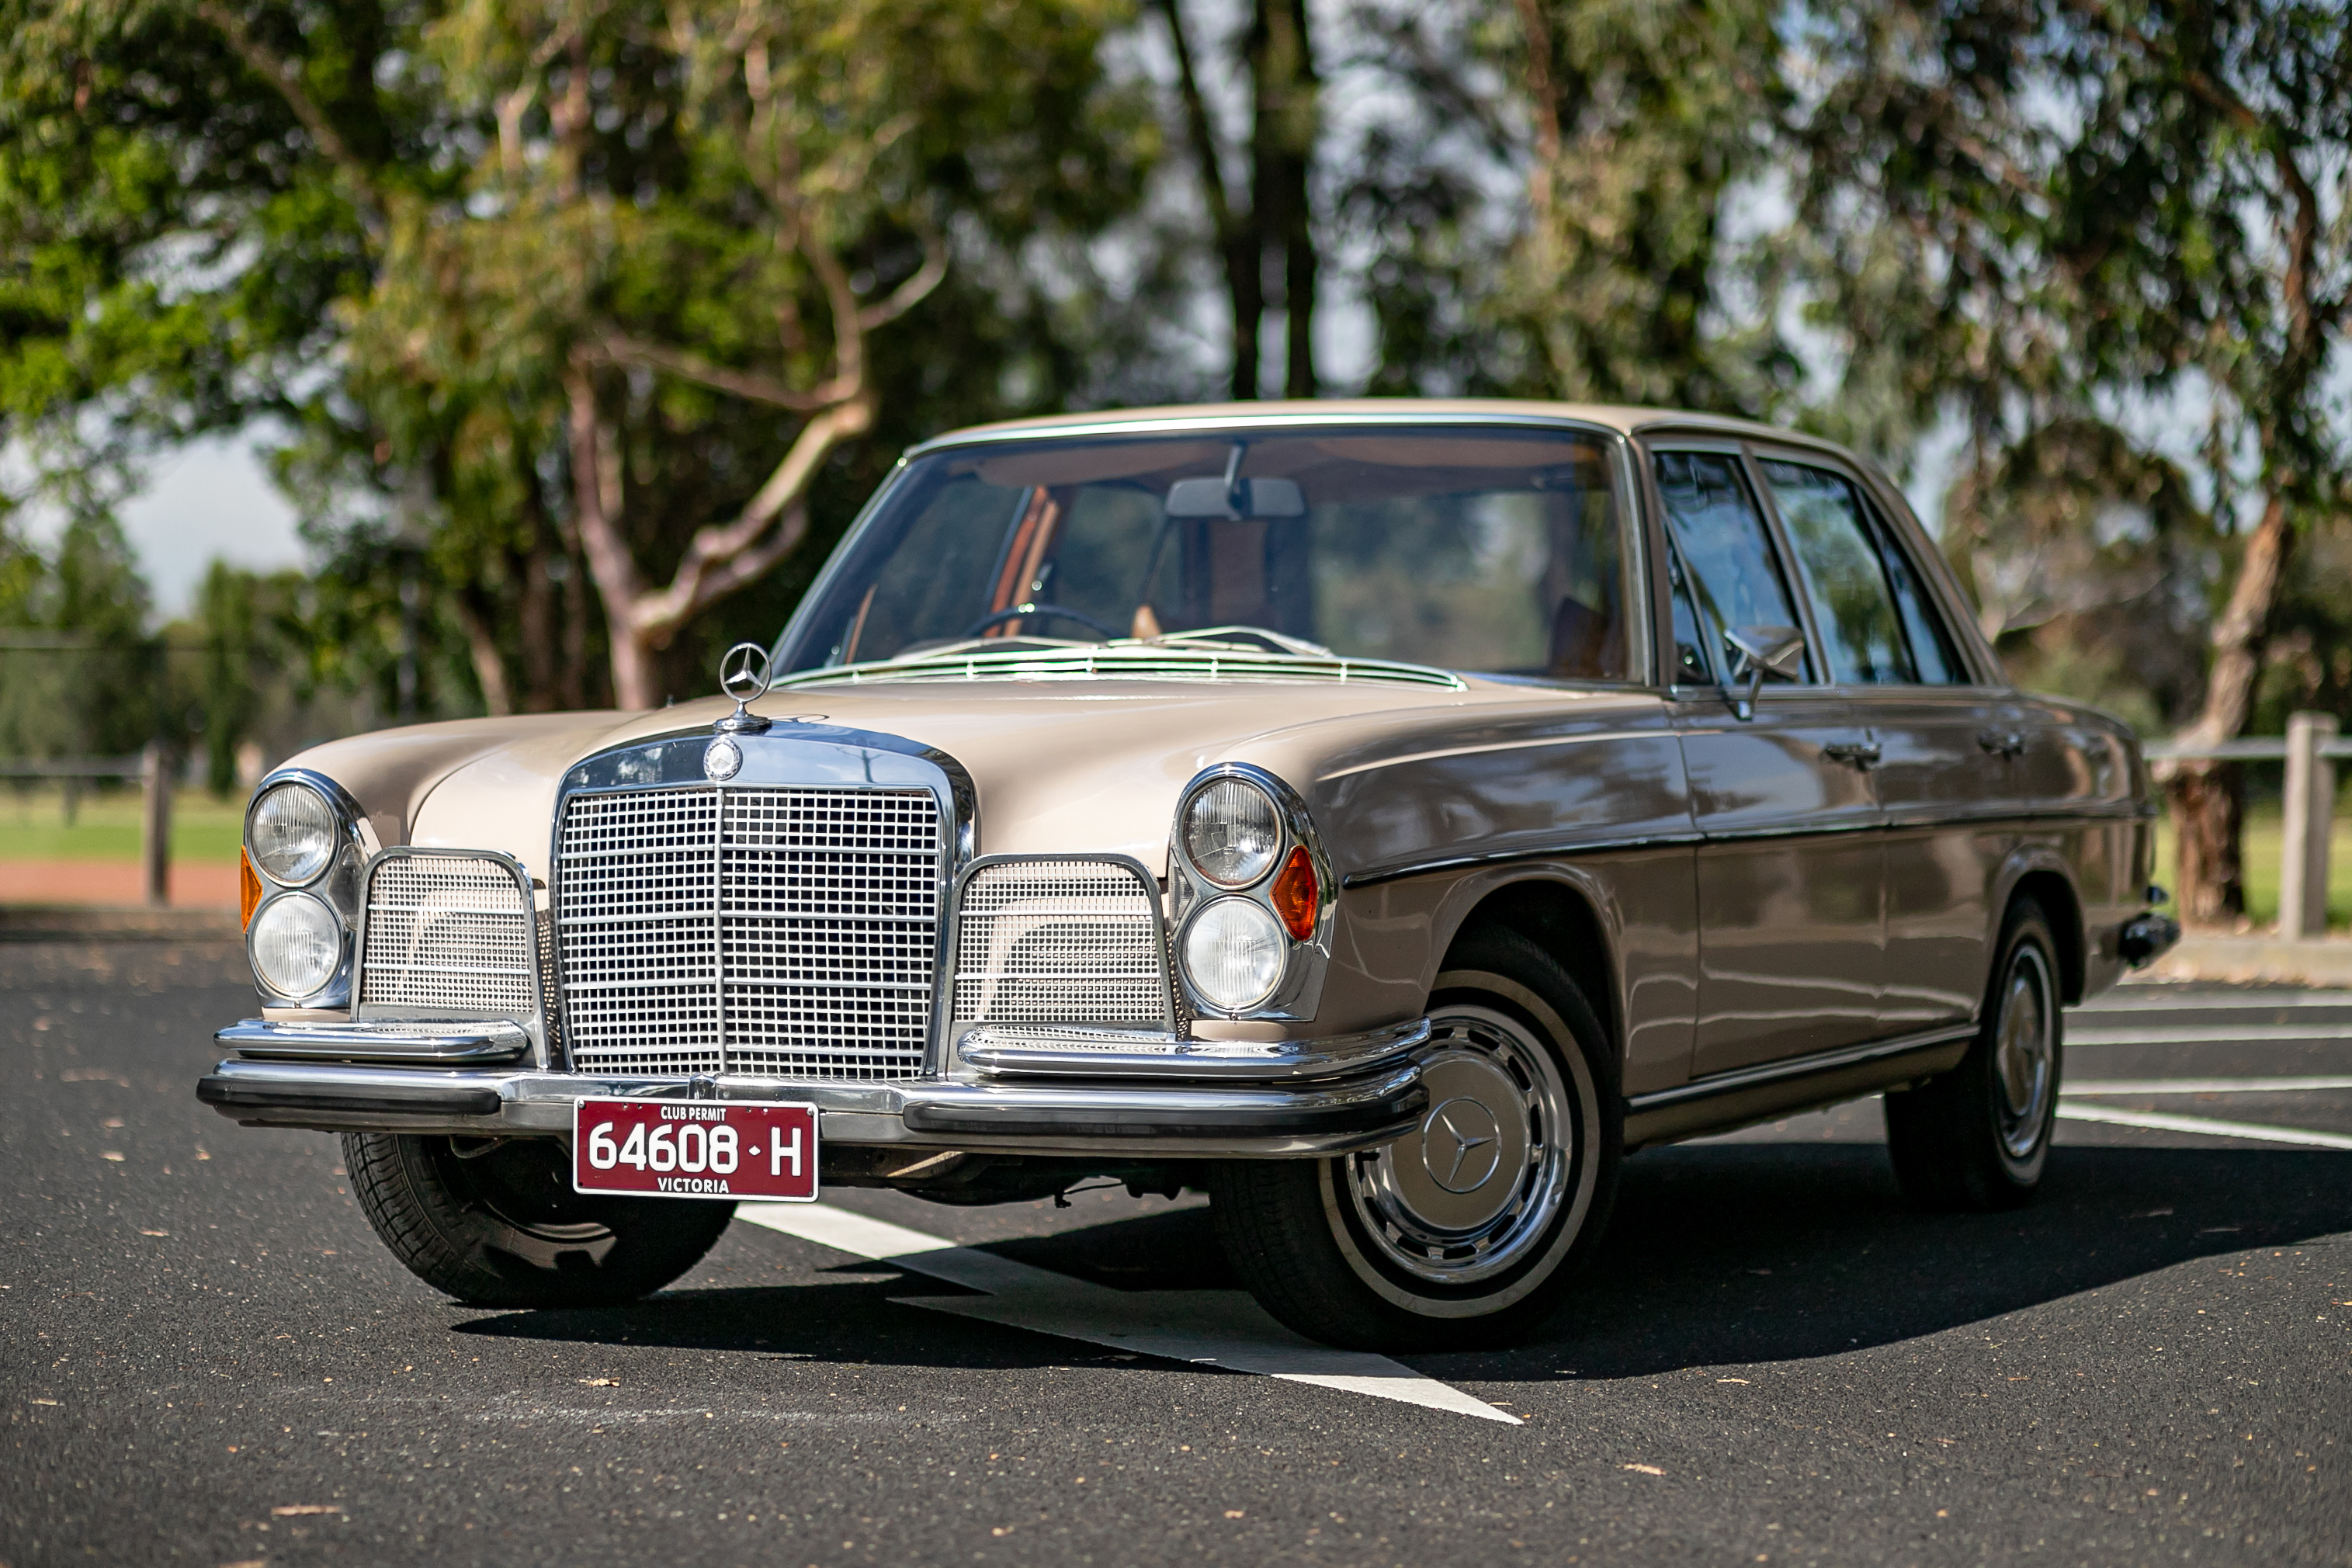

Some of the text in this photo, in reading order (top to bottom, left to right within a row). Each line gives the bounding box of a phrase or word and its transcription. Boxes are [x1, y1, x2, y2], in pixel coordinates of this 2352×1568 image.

[661, 1105, 727, 1122] CLUB PERMIT
[589, 1122, 738, 1174] 64608
[657, 1177, 730, 1194] VICTORIA
